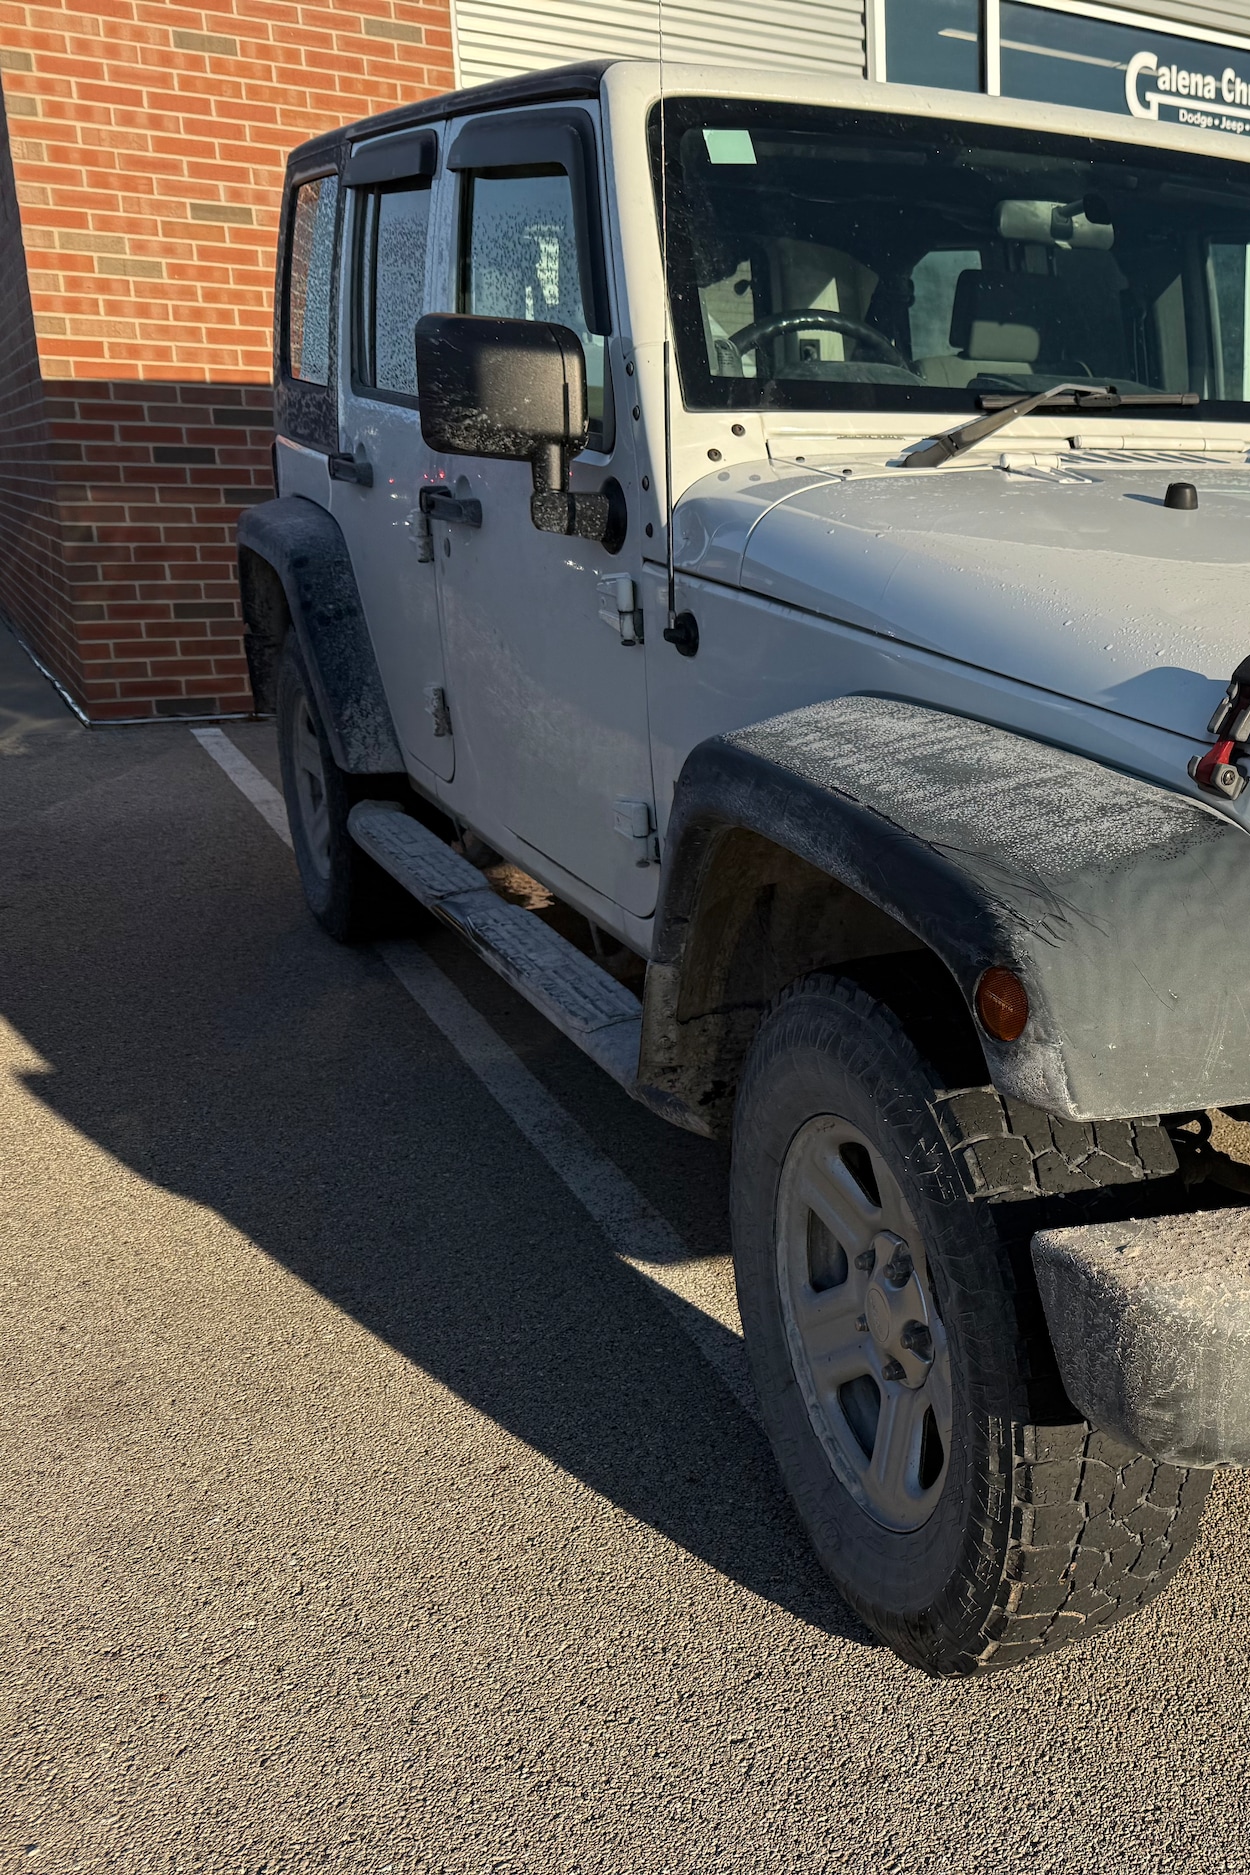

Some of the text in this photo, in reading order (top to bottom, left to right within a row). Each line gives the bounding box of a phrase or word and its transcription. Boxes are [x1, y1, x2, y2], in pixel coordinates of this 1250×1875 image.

[1126, 51, 1216, 121] Galena
[1179, 109, 1213, 128] Dodge
[1220, 116, 1244, 134] Jeep
